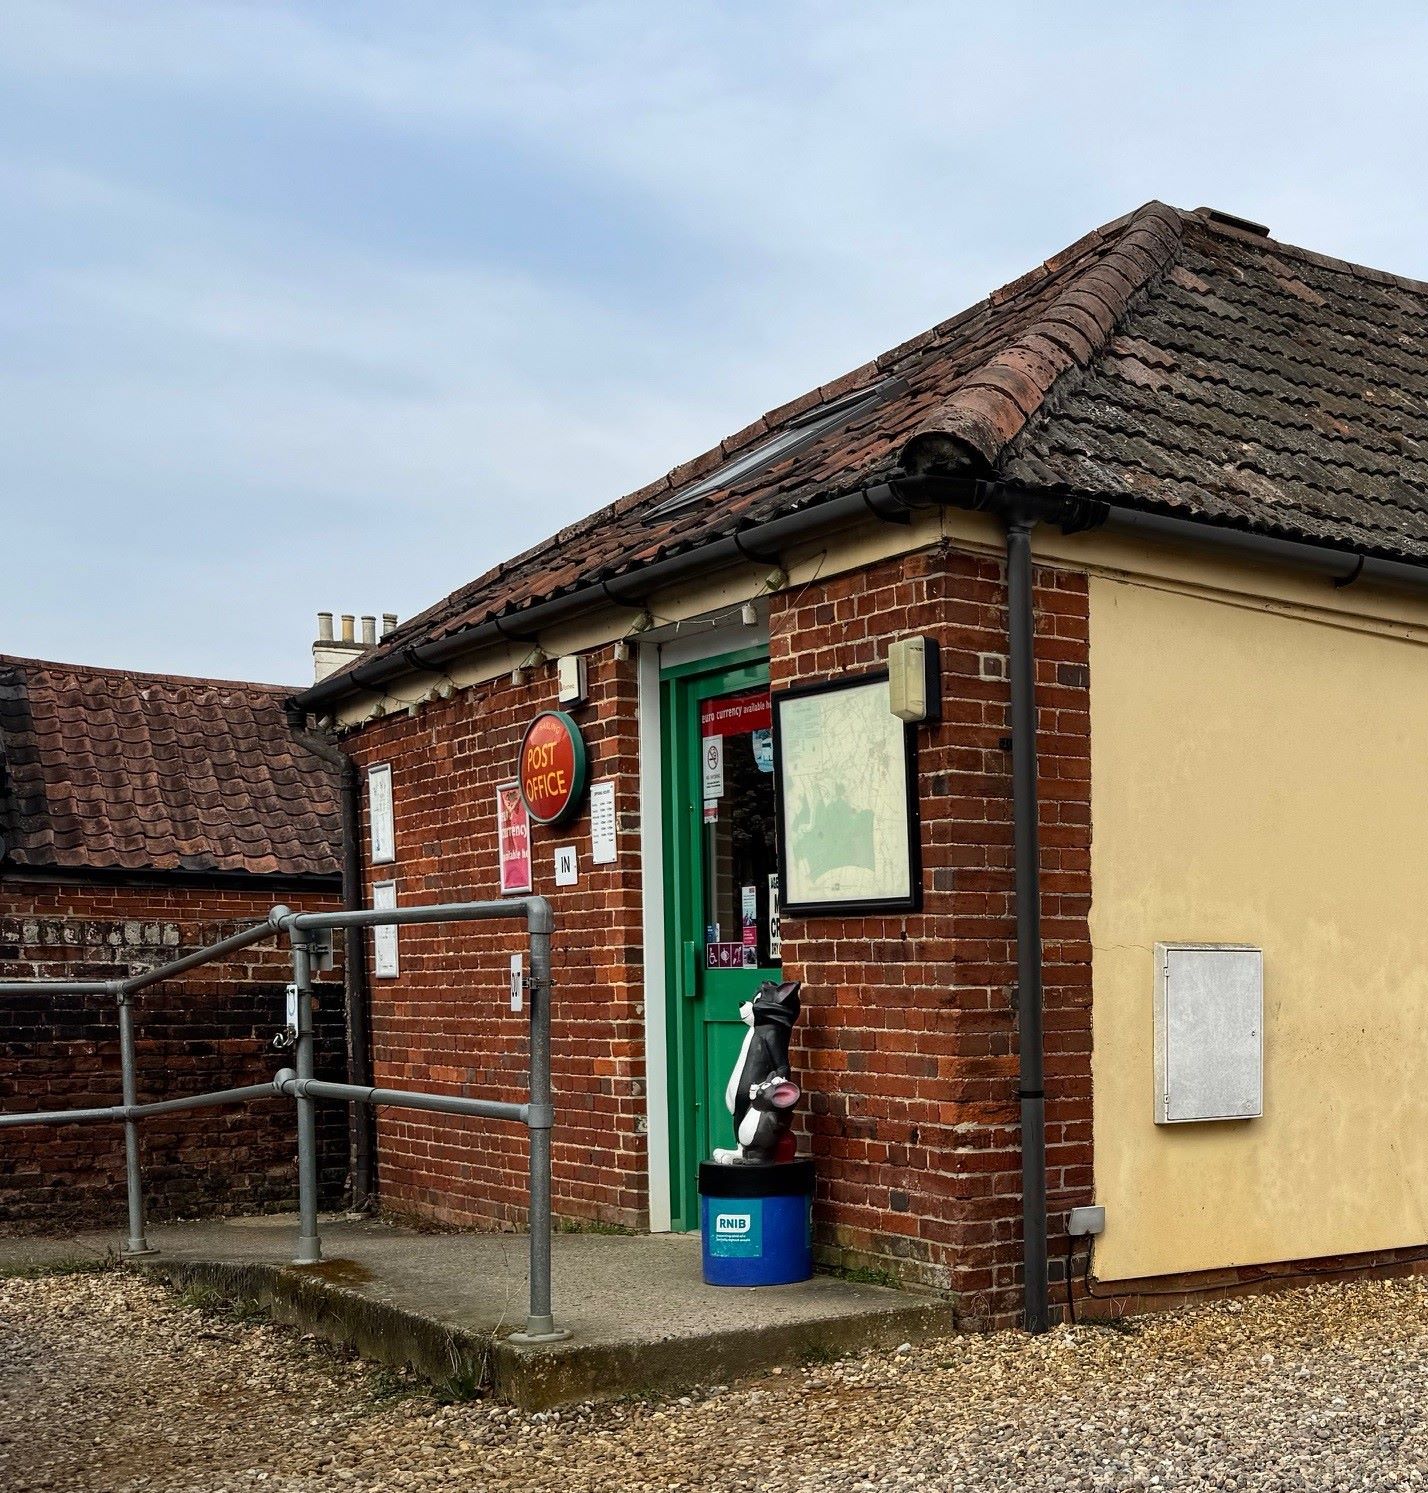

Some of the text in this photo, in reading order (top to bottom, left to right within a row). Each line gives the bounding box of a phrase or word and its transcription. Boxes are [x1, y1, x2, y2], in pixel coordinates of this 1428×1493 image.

[702, 712, 715, 724] euro
[716, 706, 742, 718] currency
[743, 701, 765, 713] available
[527, 741, 558, 772] POST
[526, 770, 568, 803] OFFICE
[561, 856, 571, 874] IN
[719, 1218, 747, 1229] RNIB
